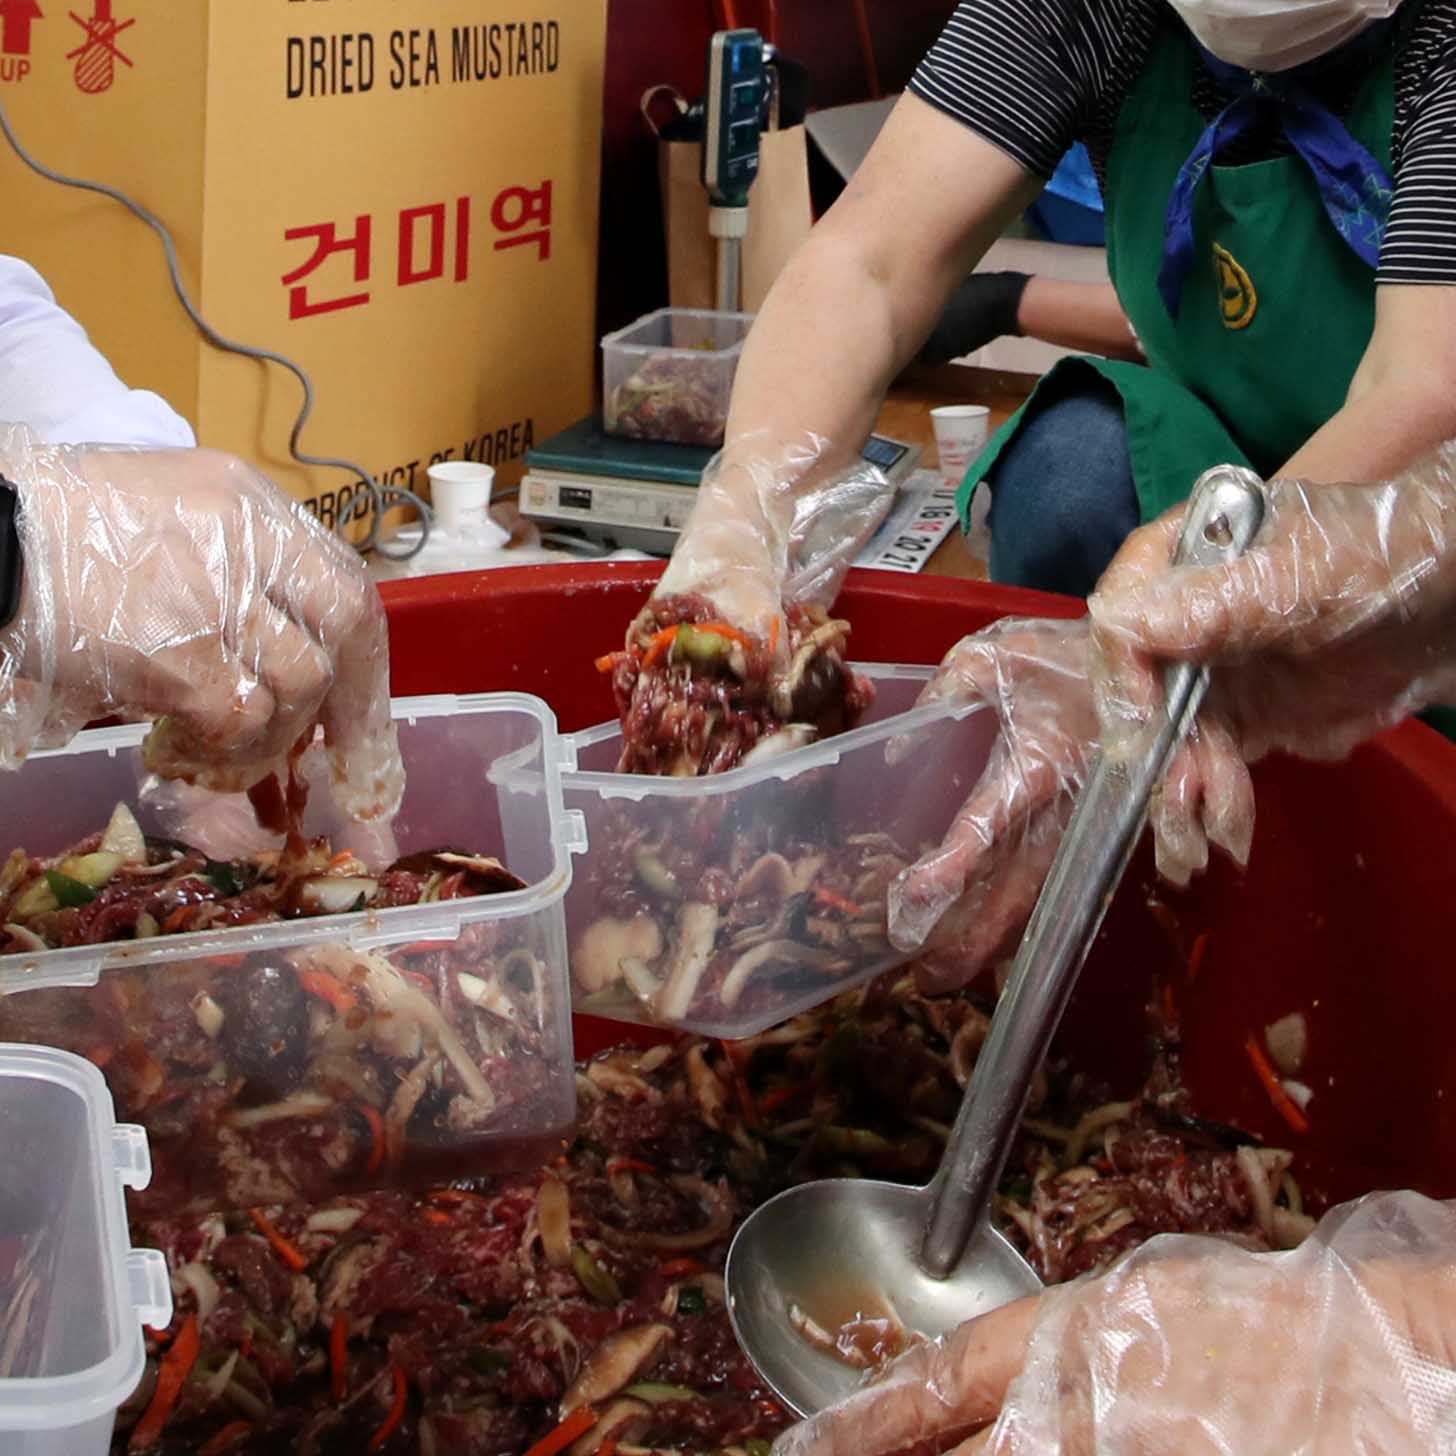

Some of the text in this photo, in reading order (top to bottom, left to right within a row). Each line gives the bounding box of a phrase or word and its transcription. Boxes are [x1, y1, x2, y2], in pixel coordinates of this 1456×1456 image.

[0, 58, 31, 82] UP
[287, 20, 559, 99] DRIED SEA MUSTARD
[281, 179, 553, 320] 건미역
